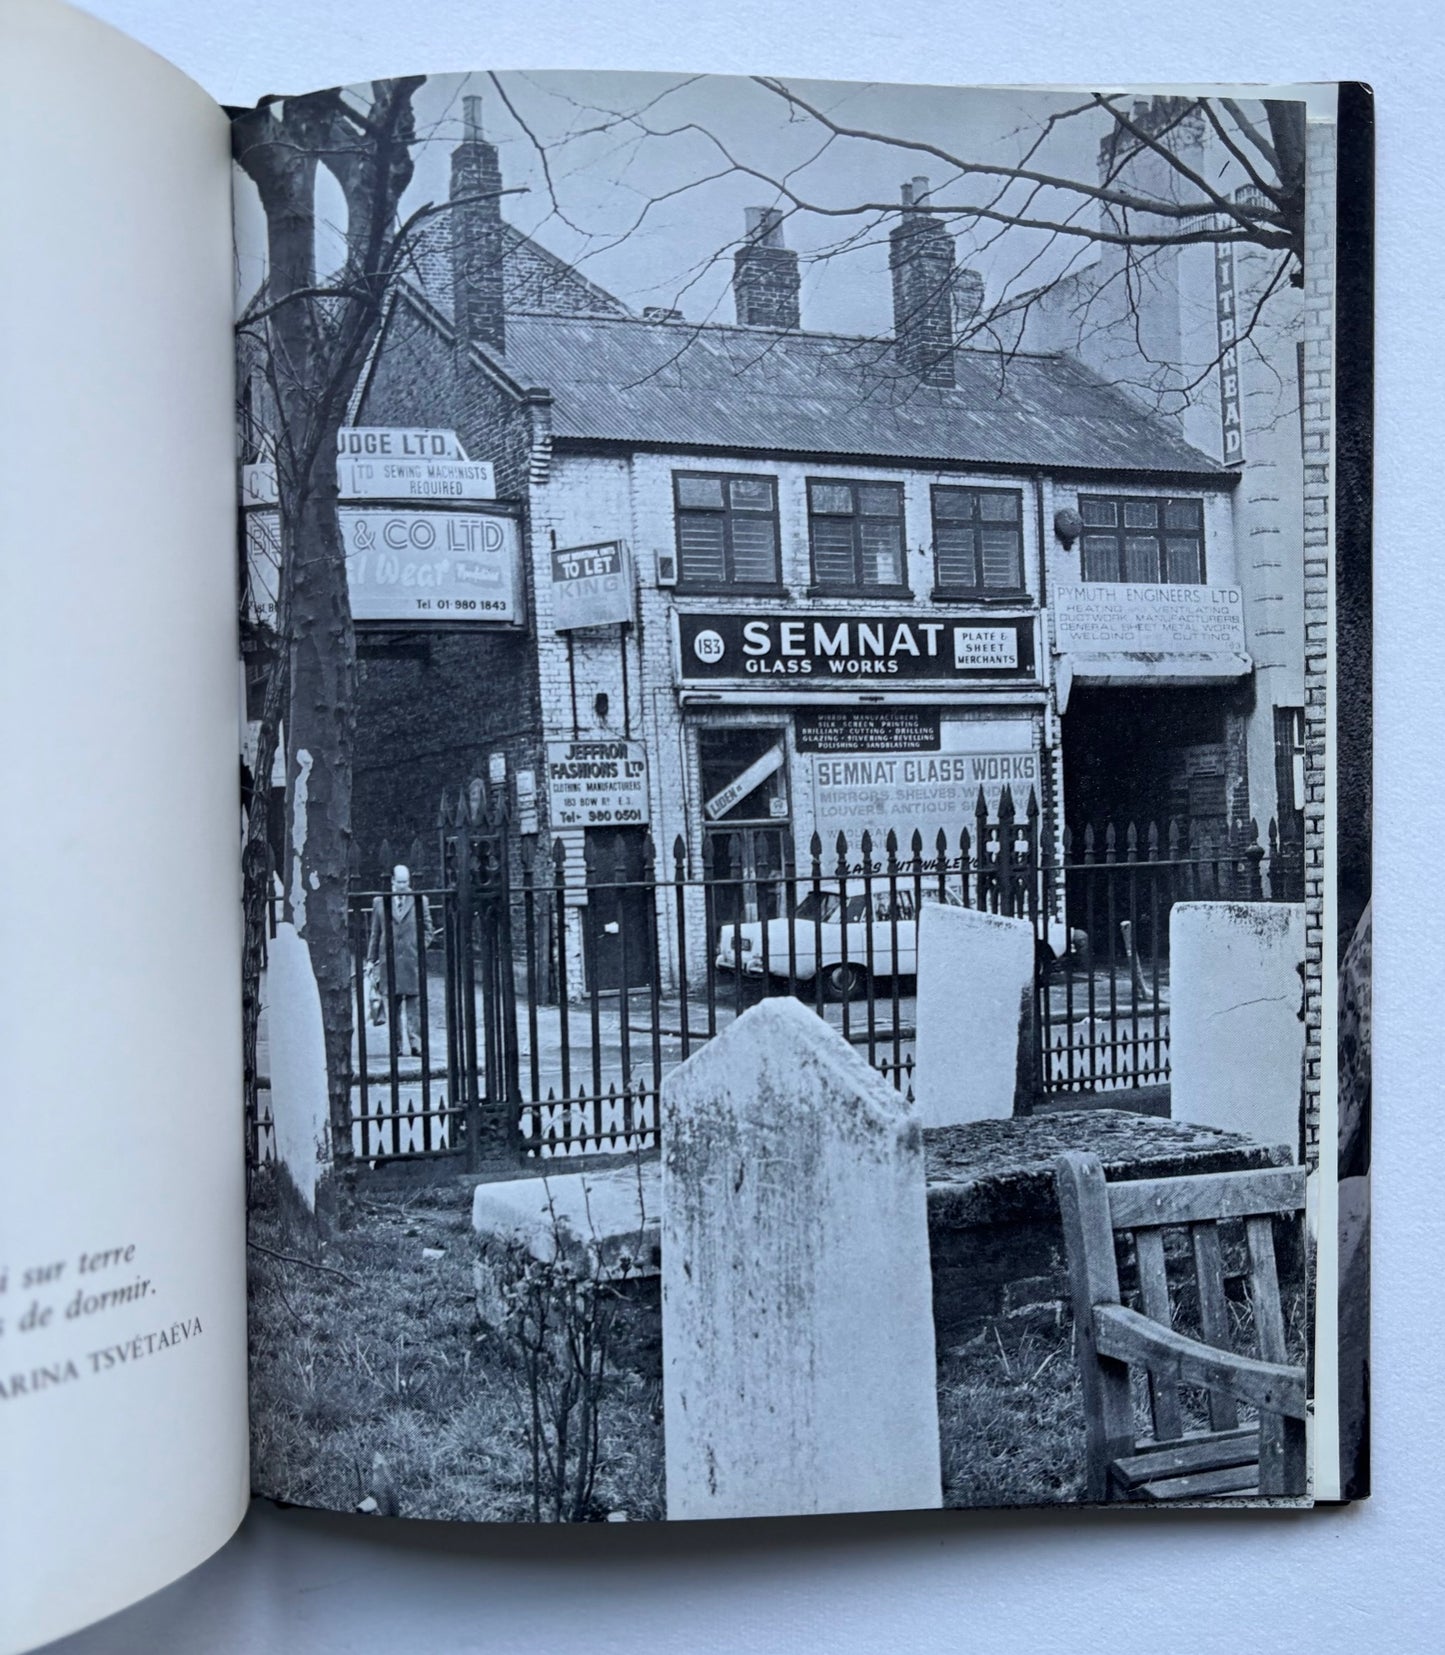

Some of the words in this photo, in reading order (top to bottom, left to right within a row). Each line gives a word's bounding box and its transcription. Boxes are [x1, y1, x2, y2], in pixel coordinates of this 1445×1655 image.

[403, 434, 452, 456] LTD.
[384, 465, 422, 478] SEWING
[410, 480, 463, 496] REQUIRED
[354, 519, 376, 551] &
[562, 562, 579, 579] TO
[584, 556, 613, 576] LET
[560, 576, 619, 600] KING
[1057, 586, 1116, 602] PYMUTH
[1126, 588, 1201, 604] ENGINEERS
[1211, 590, 1239, 604] LTD
[455, 600, 476, 610] 980
[480, 601, 507, 611] 1843
[1066, 605, 1122, 613] HEATING
[1152, 606, 1230, 615] VENTILATING
[1059, 613, 1128, 622] DUCTWORK
[1135, 614, 1240, 624] MANUFACTURERS
[1203, 624, 1240, 632] WORK
[698, 638, 721, 654] 183
[742, 620, 944, 656] SEMNAT
[962, 632, 996, 641] PLATE
[1070, 632, 1135, 640] WELDING
[1172, 633, 1231, 641] CUTTING
[965, 643, 1004, 653] SHEET
[745, 659, 812, 674] GLASS
[828, 659, 899, 674] WORKS
[957, 655, 1016, 664] MERCHANTS
[565, 743, 628, 761] JEFFRON
[550, 762, 618, 780] FASHIONS
[818, 760, 897, 786] SEMNAT
[904, 758, 964, 783] GLASS
[972, 756, 1035, 780] WORKS
[553, 782, 581, 793] CLOTHING
[586, 781, 641, 792] MANUFACTURERS
[580, 798, 598, 807] BOW
[891, 799, 956, 814] ANTIQUE
[588, 810, 612, 822] 980
[614, 809, 642, 821] 0501
[22, 1261, 66, 1289] sur
[77, 1243, 136, 1275] terre
[18, 1299, 53, 1333] de
[64, 1275, 157, 1319] dormir.
[88, 1316, 203, 1373] TSVÉTAÉVA
